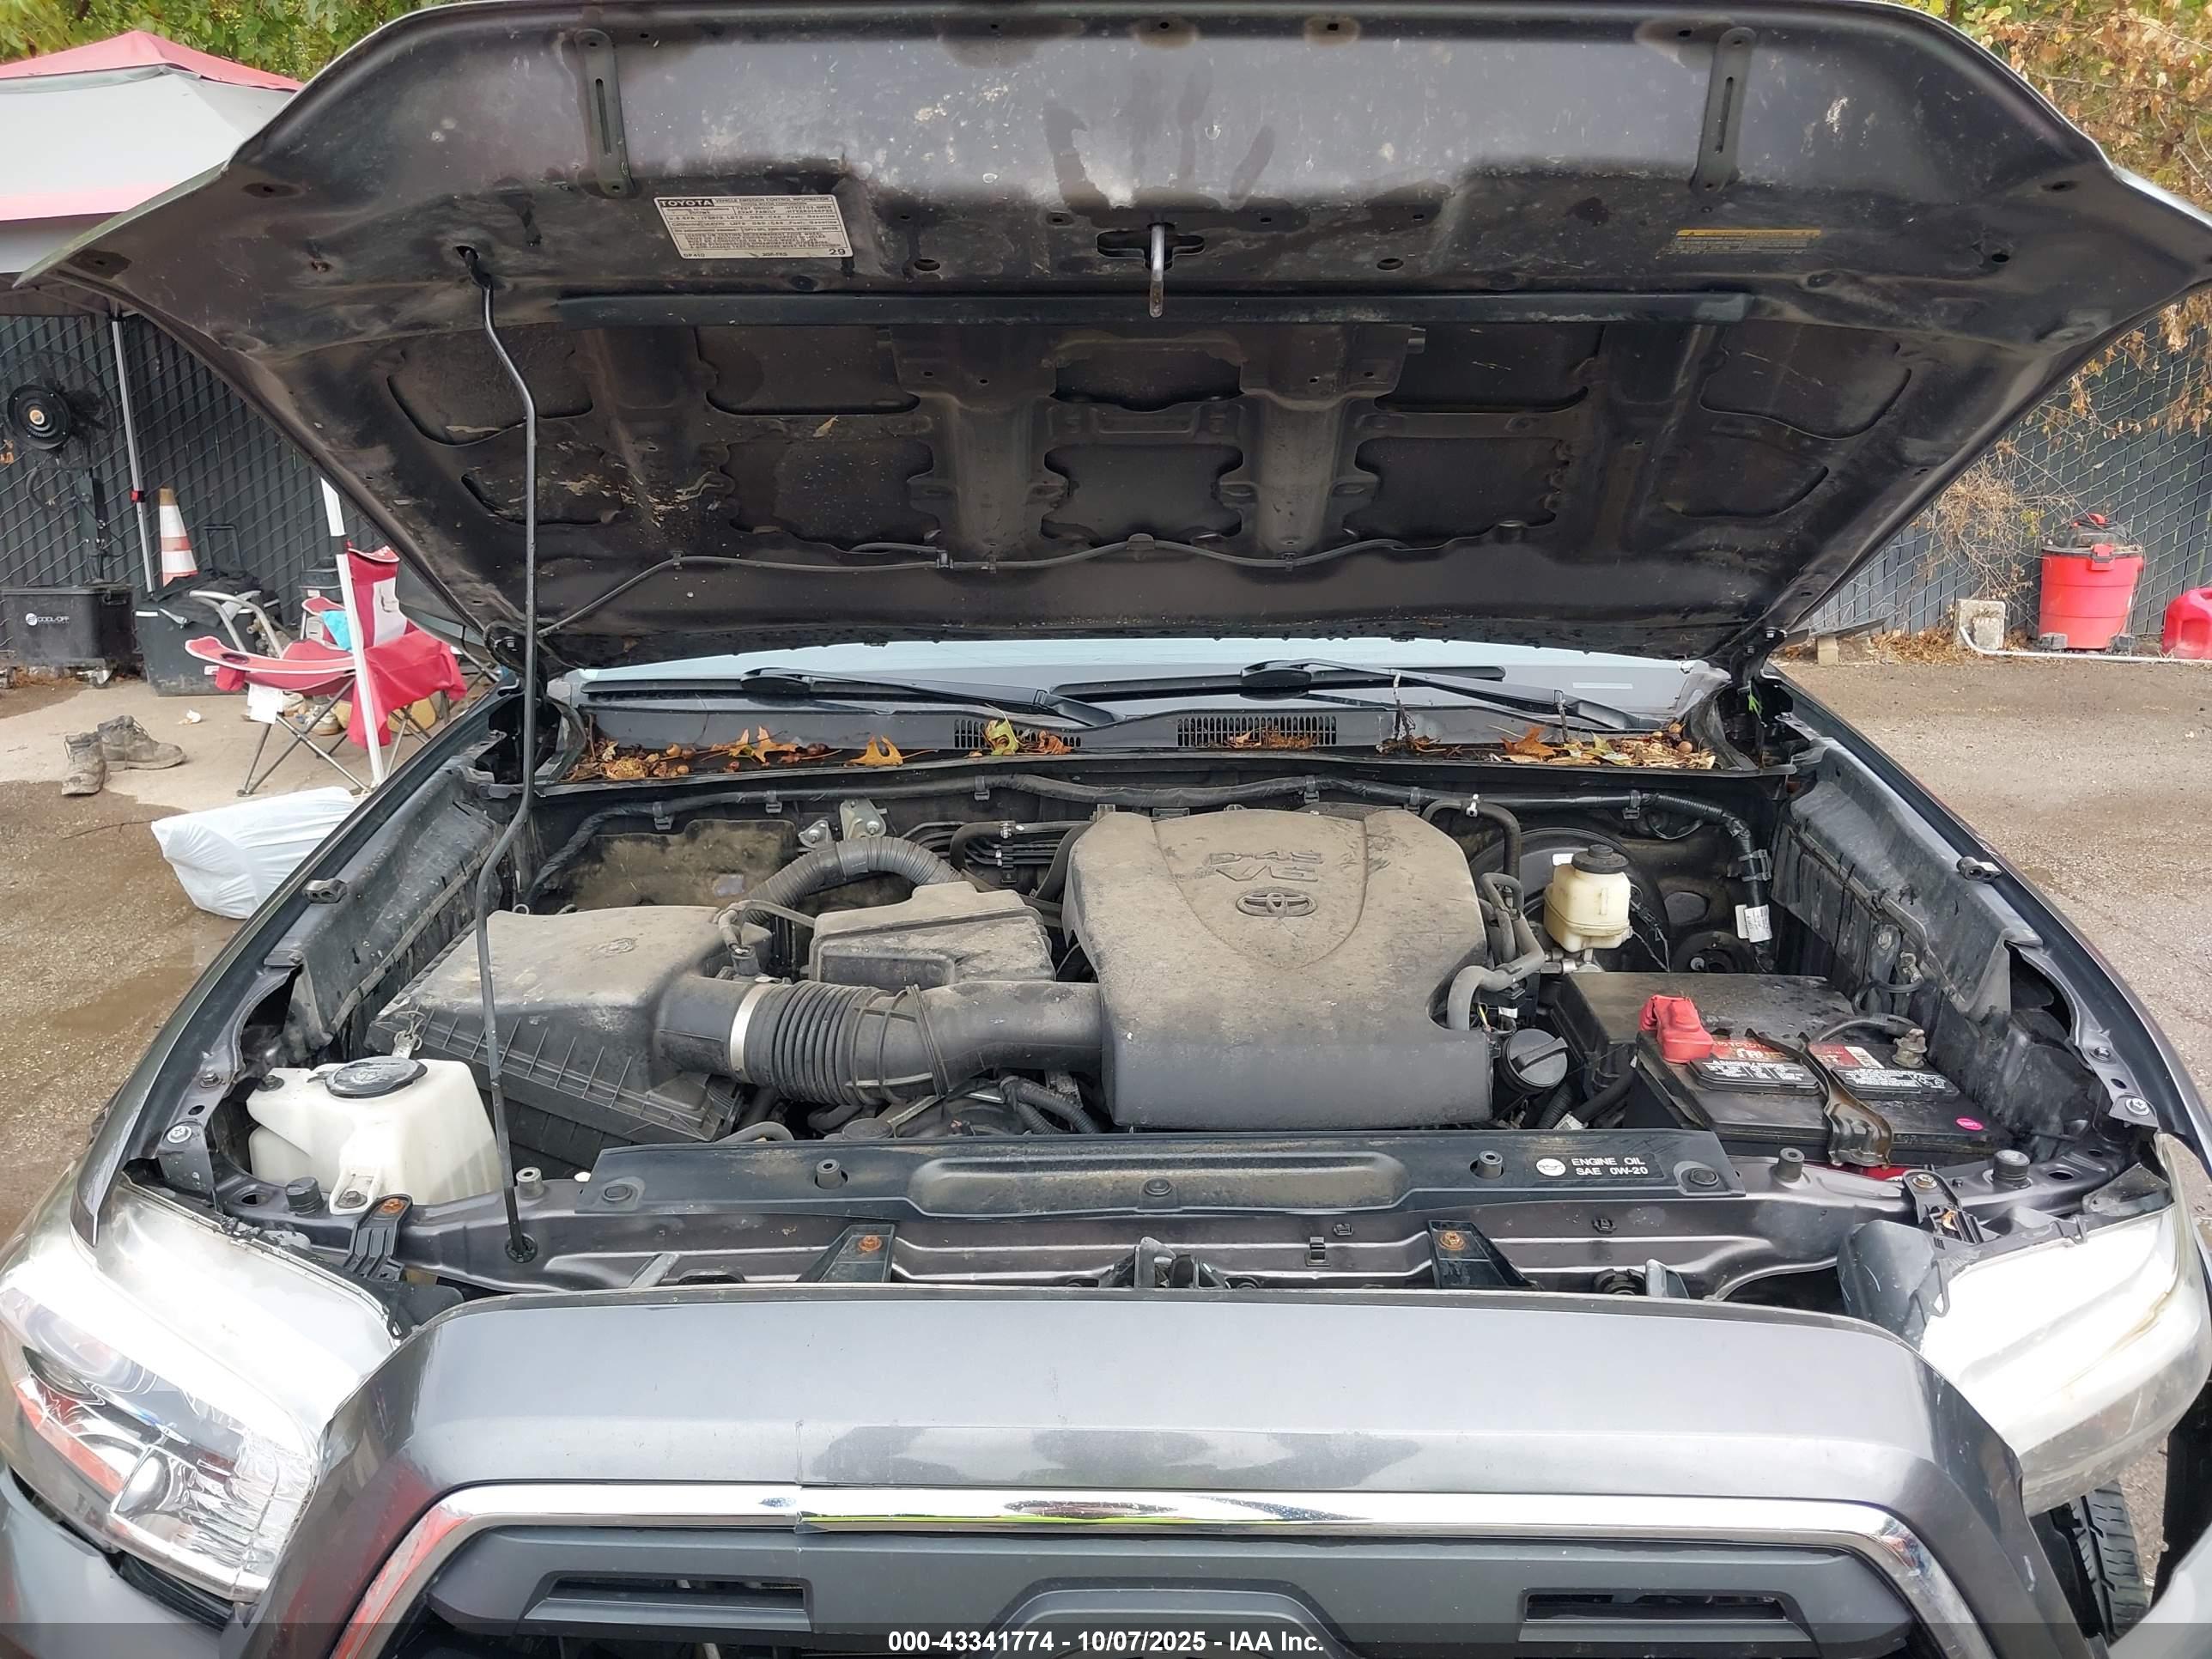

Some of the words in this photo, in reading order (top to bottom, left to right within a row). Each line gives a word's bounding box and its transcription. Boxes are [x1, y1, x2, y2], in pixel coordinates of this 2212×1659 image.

[1571, 1158, 1618, 1166] ENGINE
[1624, 1157, 1645, 1165] OIL
[1610, 1166, 1649, 1175] 0W-20
